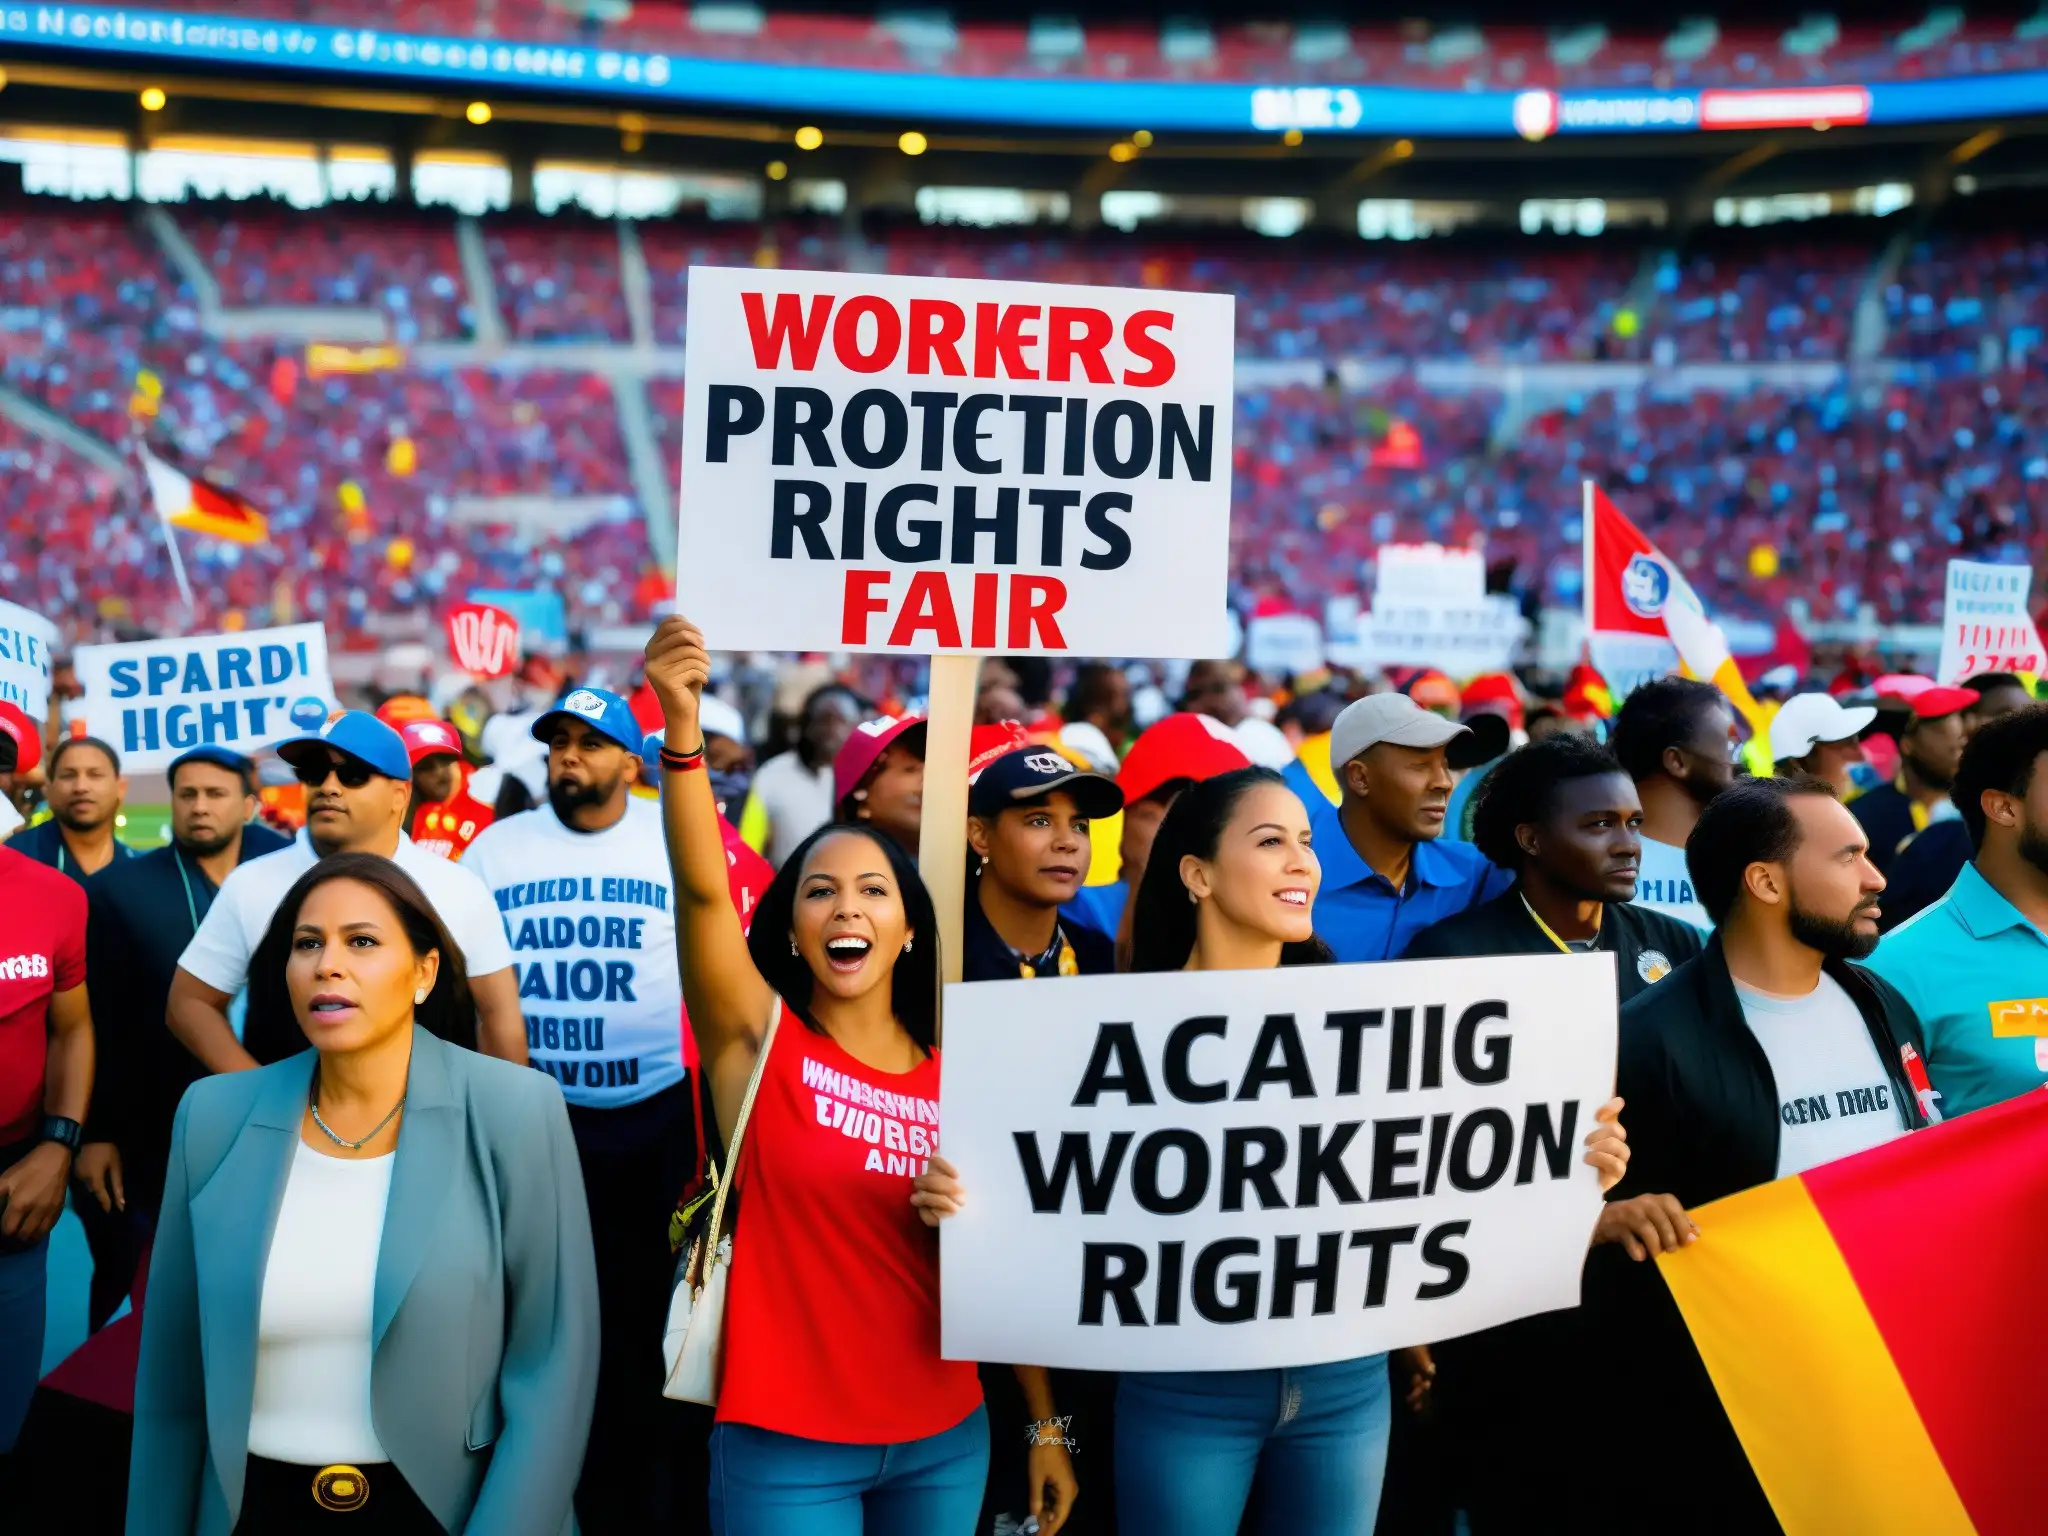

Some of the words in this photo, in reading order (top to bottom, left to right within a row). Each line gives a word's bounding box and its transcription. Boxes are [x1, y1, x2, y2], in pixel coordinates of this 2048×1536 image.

[740, 292, 1176, 388] WORKERS
[770, 479, 1133, 571] RIGHTS
[840, 570, 1068, 650] FAIR
[1078, 1219, 1471, 1328] RIGHTS
